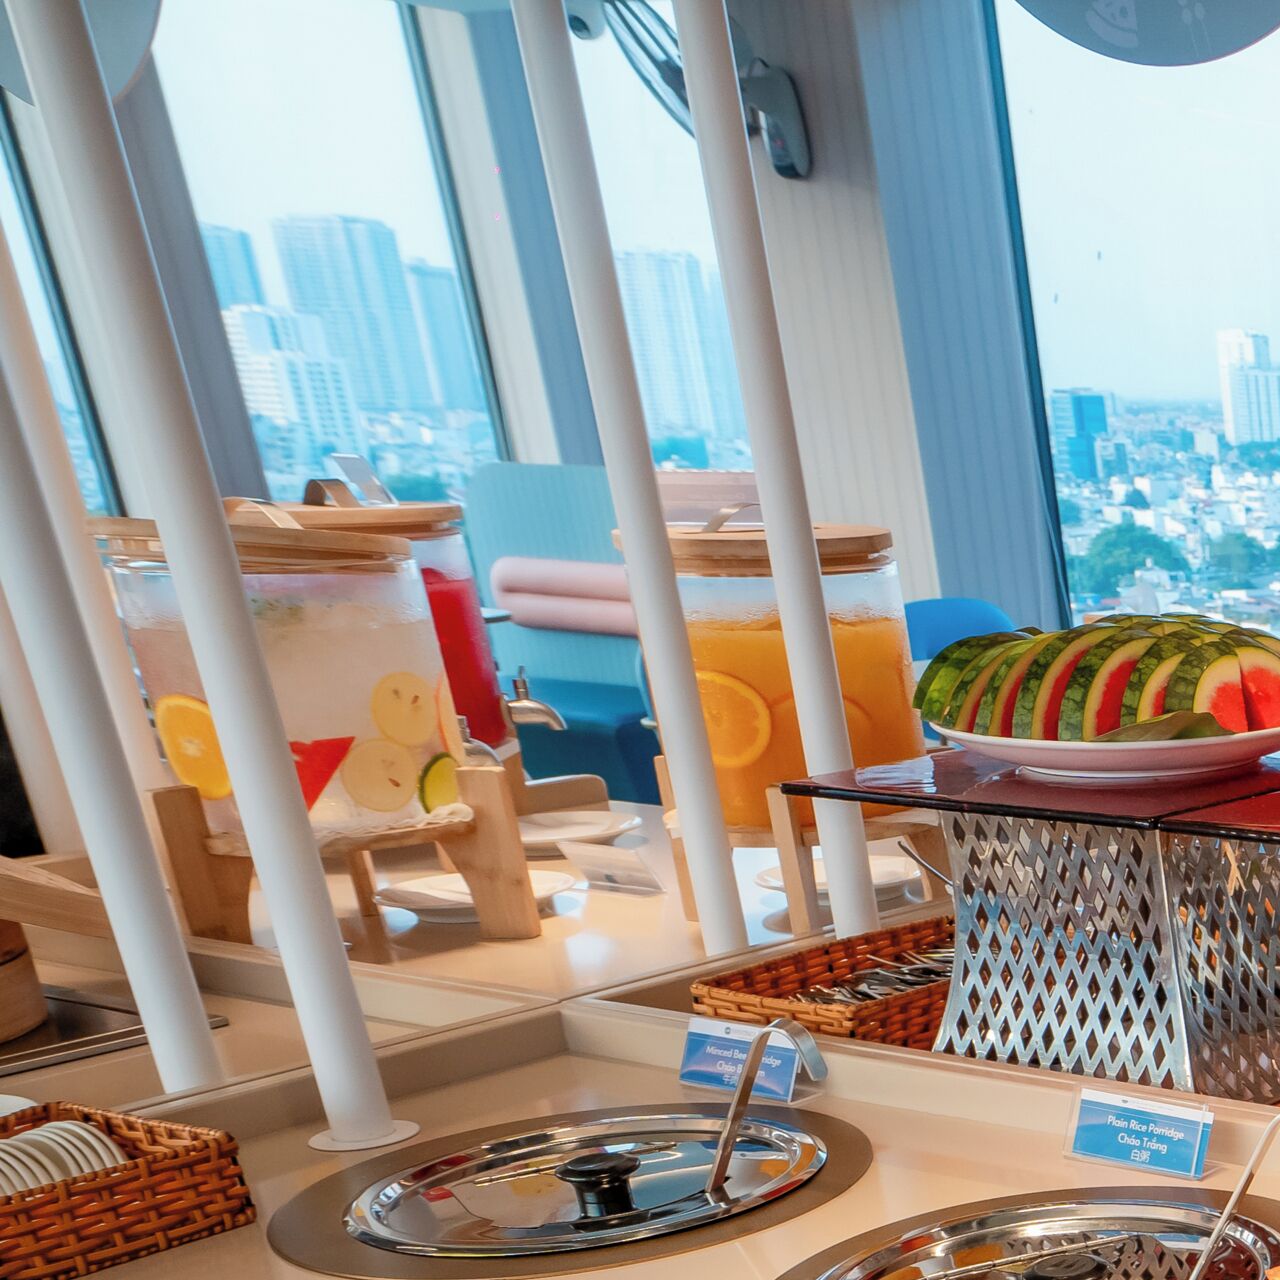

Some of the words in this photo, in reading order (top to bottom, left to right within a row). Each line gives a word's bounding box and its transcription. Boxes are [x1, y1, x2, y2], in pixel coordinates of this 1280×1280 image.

[706, 1046, 732, 1057] Minced
[1108, 1116, 1128, 1129] Plain
[1130, 1120, 1147, 1132] Rice
[1149, 1124, 1185, 1140] Porridge
[1118, 1133, 1140, 1146] Cháo
